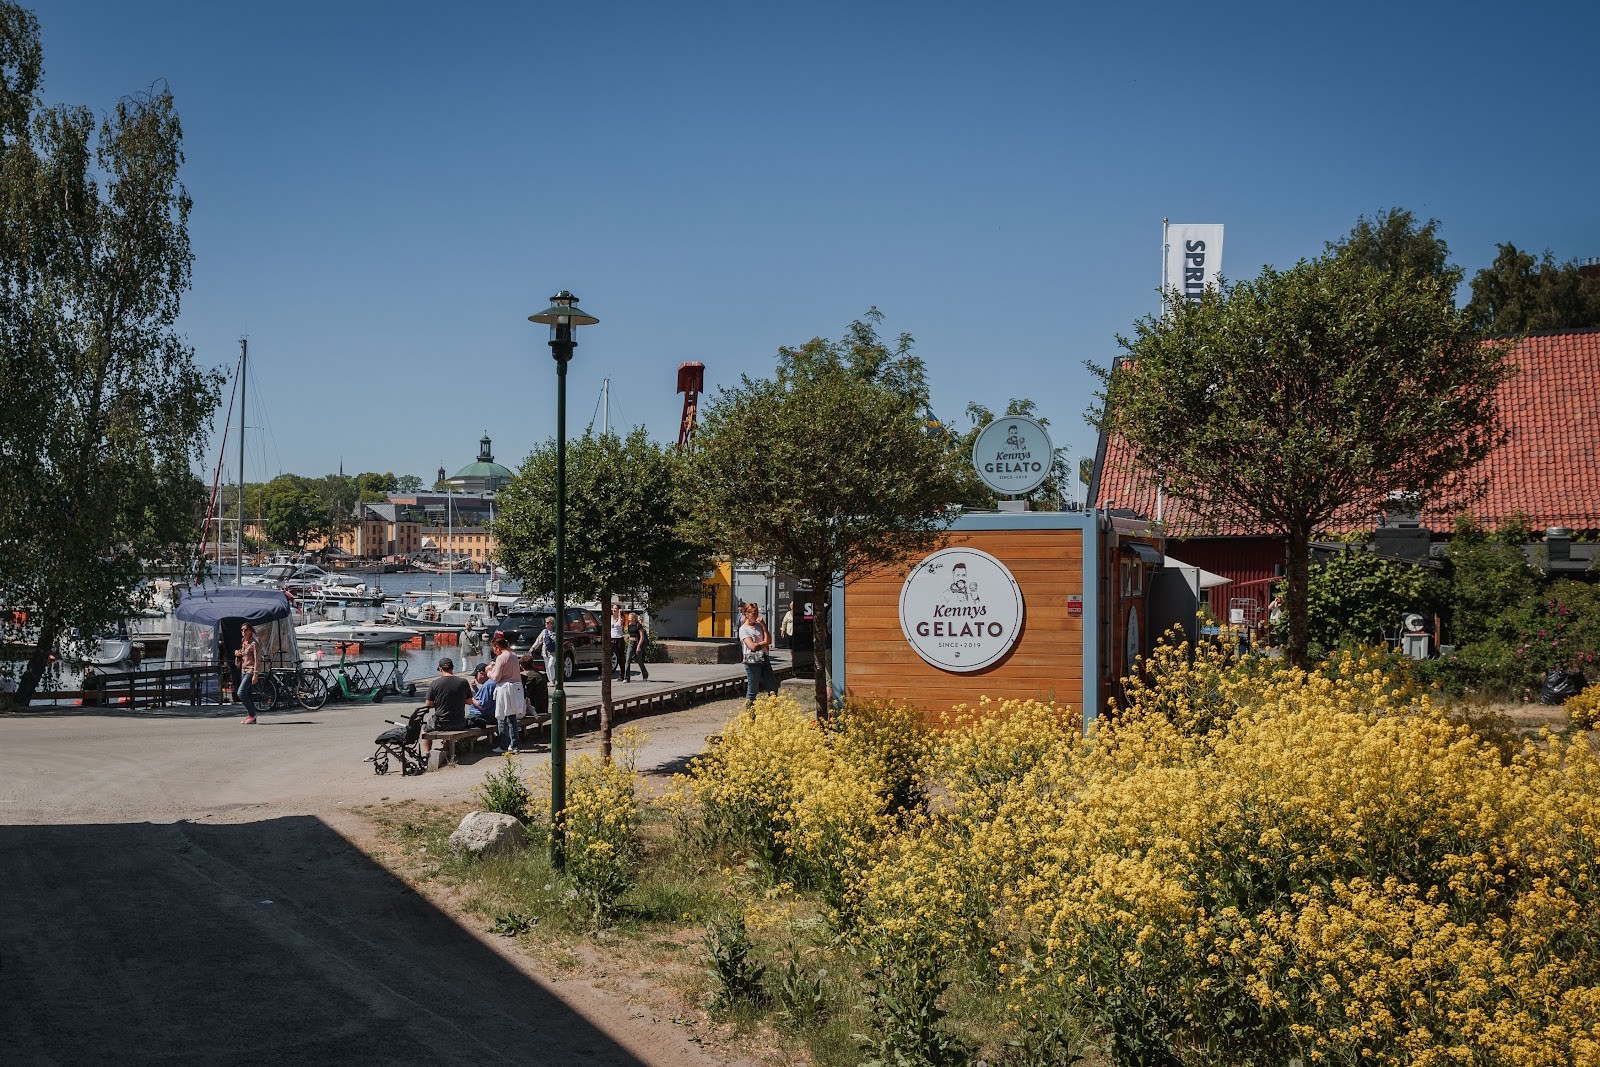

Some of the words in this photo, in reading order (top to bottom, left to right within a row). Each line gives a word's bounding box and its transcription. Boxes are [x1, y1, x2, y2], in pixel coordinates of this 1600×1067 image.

[996, 452, 1031, 461] Kennys
[985, 462, 1041, 473] GELATO
[933, 604, 987, 619] Kennys
[916, 621, 1003, 638] GELATO
